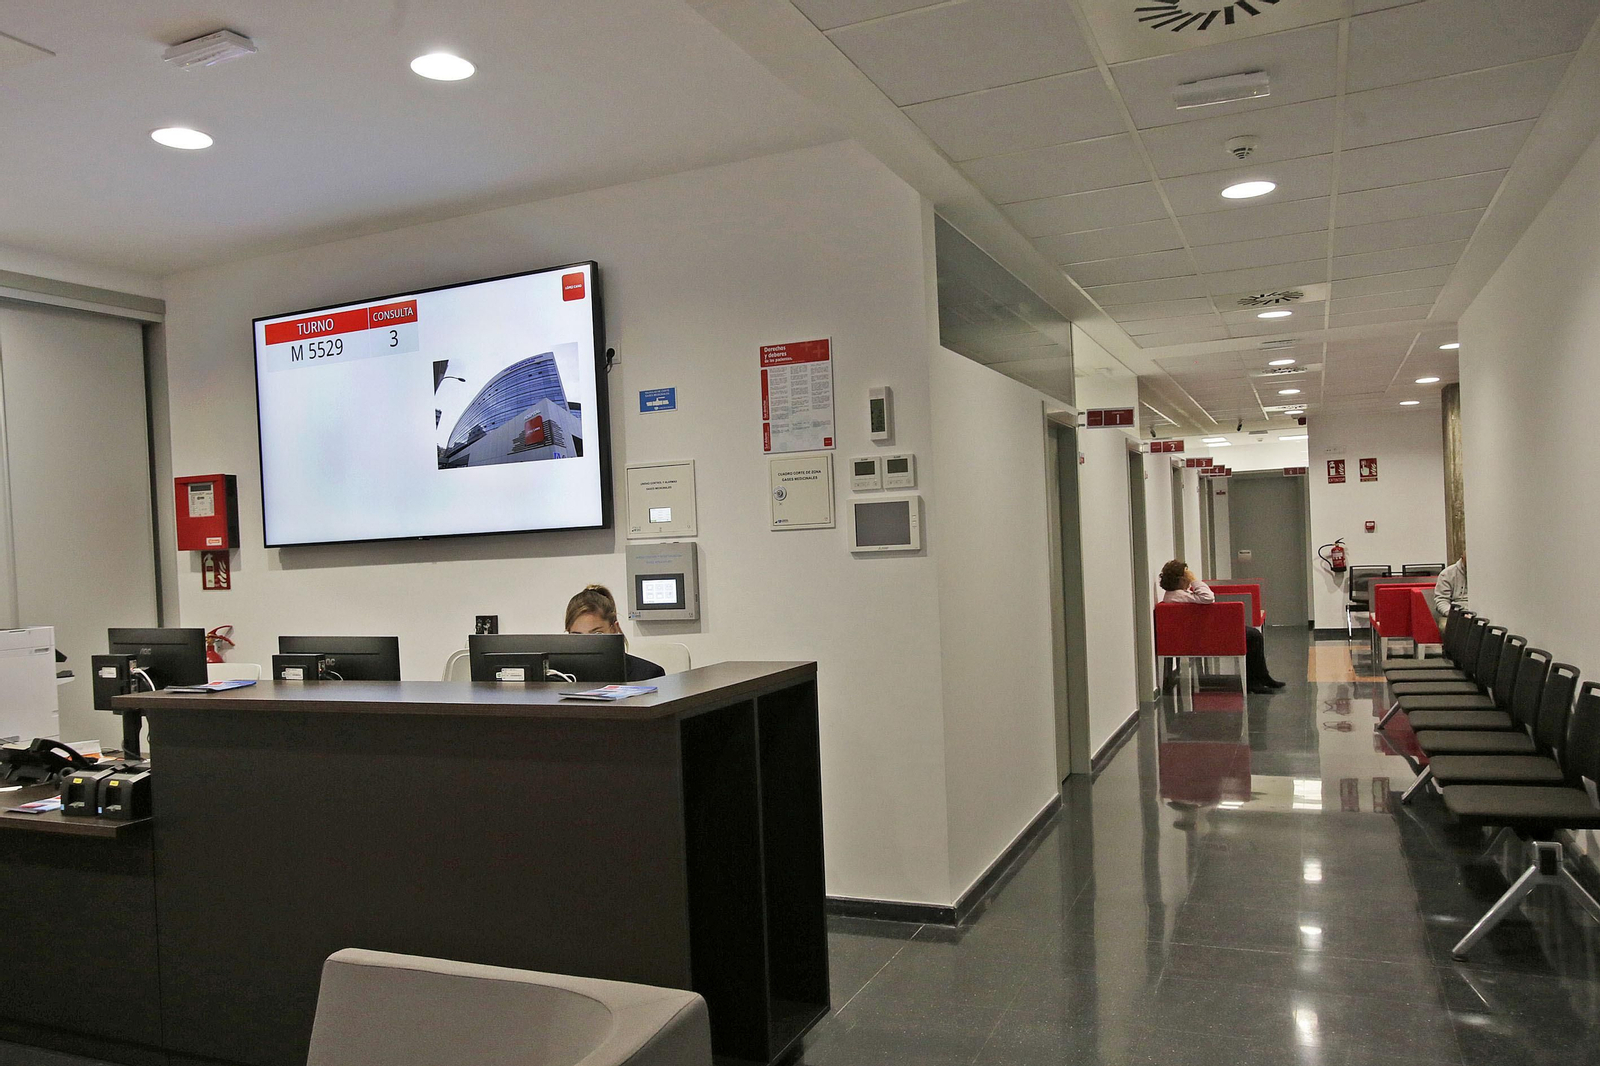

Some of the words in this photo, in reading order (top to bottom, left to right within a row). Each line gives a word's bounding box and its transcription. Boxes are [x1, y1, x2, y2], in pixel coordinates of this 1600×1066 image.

[373, 306, 414, 322] CONSULTA
[296, 318, 335, 335] TURNO
[389, 329, 399, 347] 3
[291, 344, 304, 362] M
[308, 338, 344, 360] 5529
[1116, 414, 1120, 424] 1
[326, 658, 336, 666] OC
